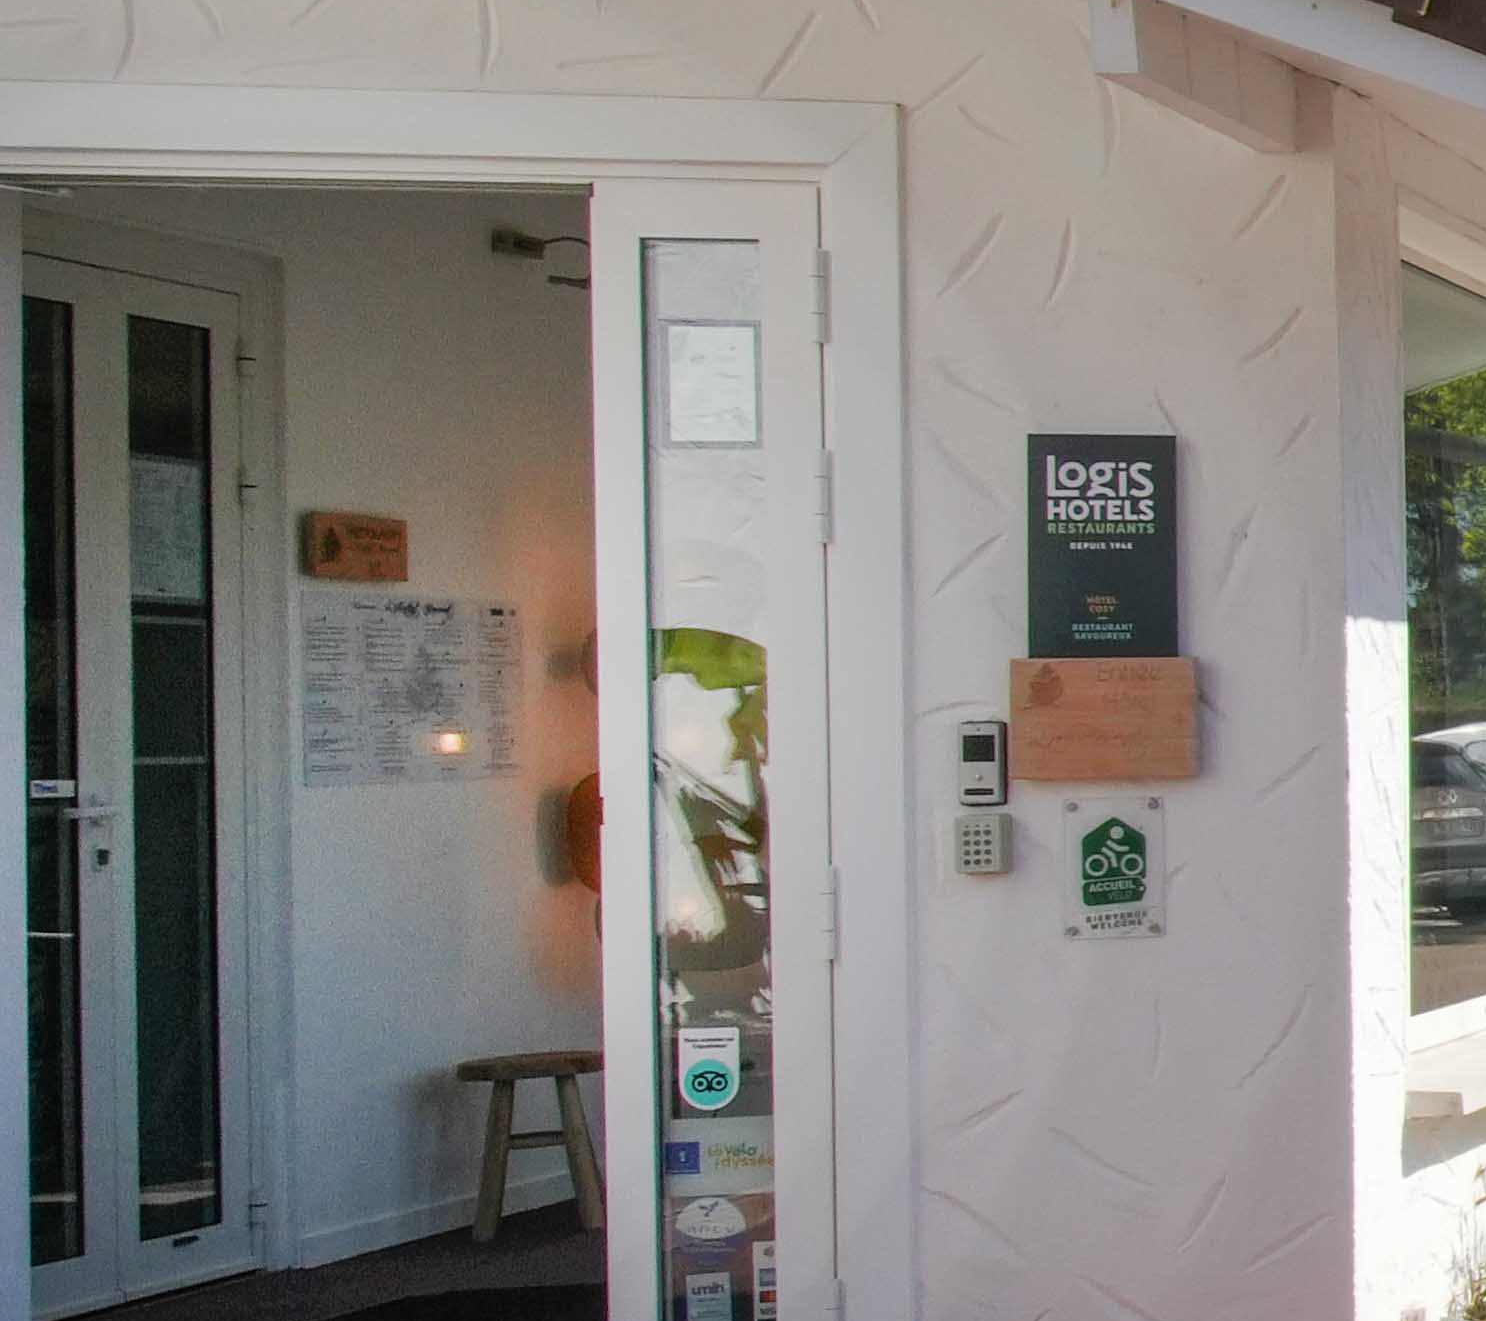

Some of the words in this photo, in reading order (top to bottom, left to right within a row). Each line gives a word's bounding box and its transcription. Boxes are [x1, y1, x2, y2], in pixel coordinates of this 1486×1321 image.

[1047, 499, 1155, 521] HOTELS
[1047, 522, 1156, 535] RESTAURANTS
[1069, 542, 1106, 550] DEPUIS
[1072, 623, 1133, 631] RESTAURANT
[1089, 880, 1136, 893] ACCUEIL
[1091, 919, 1143, 930] WELCOME
